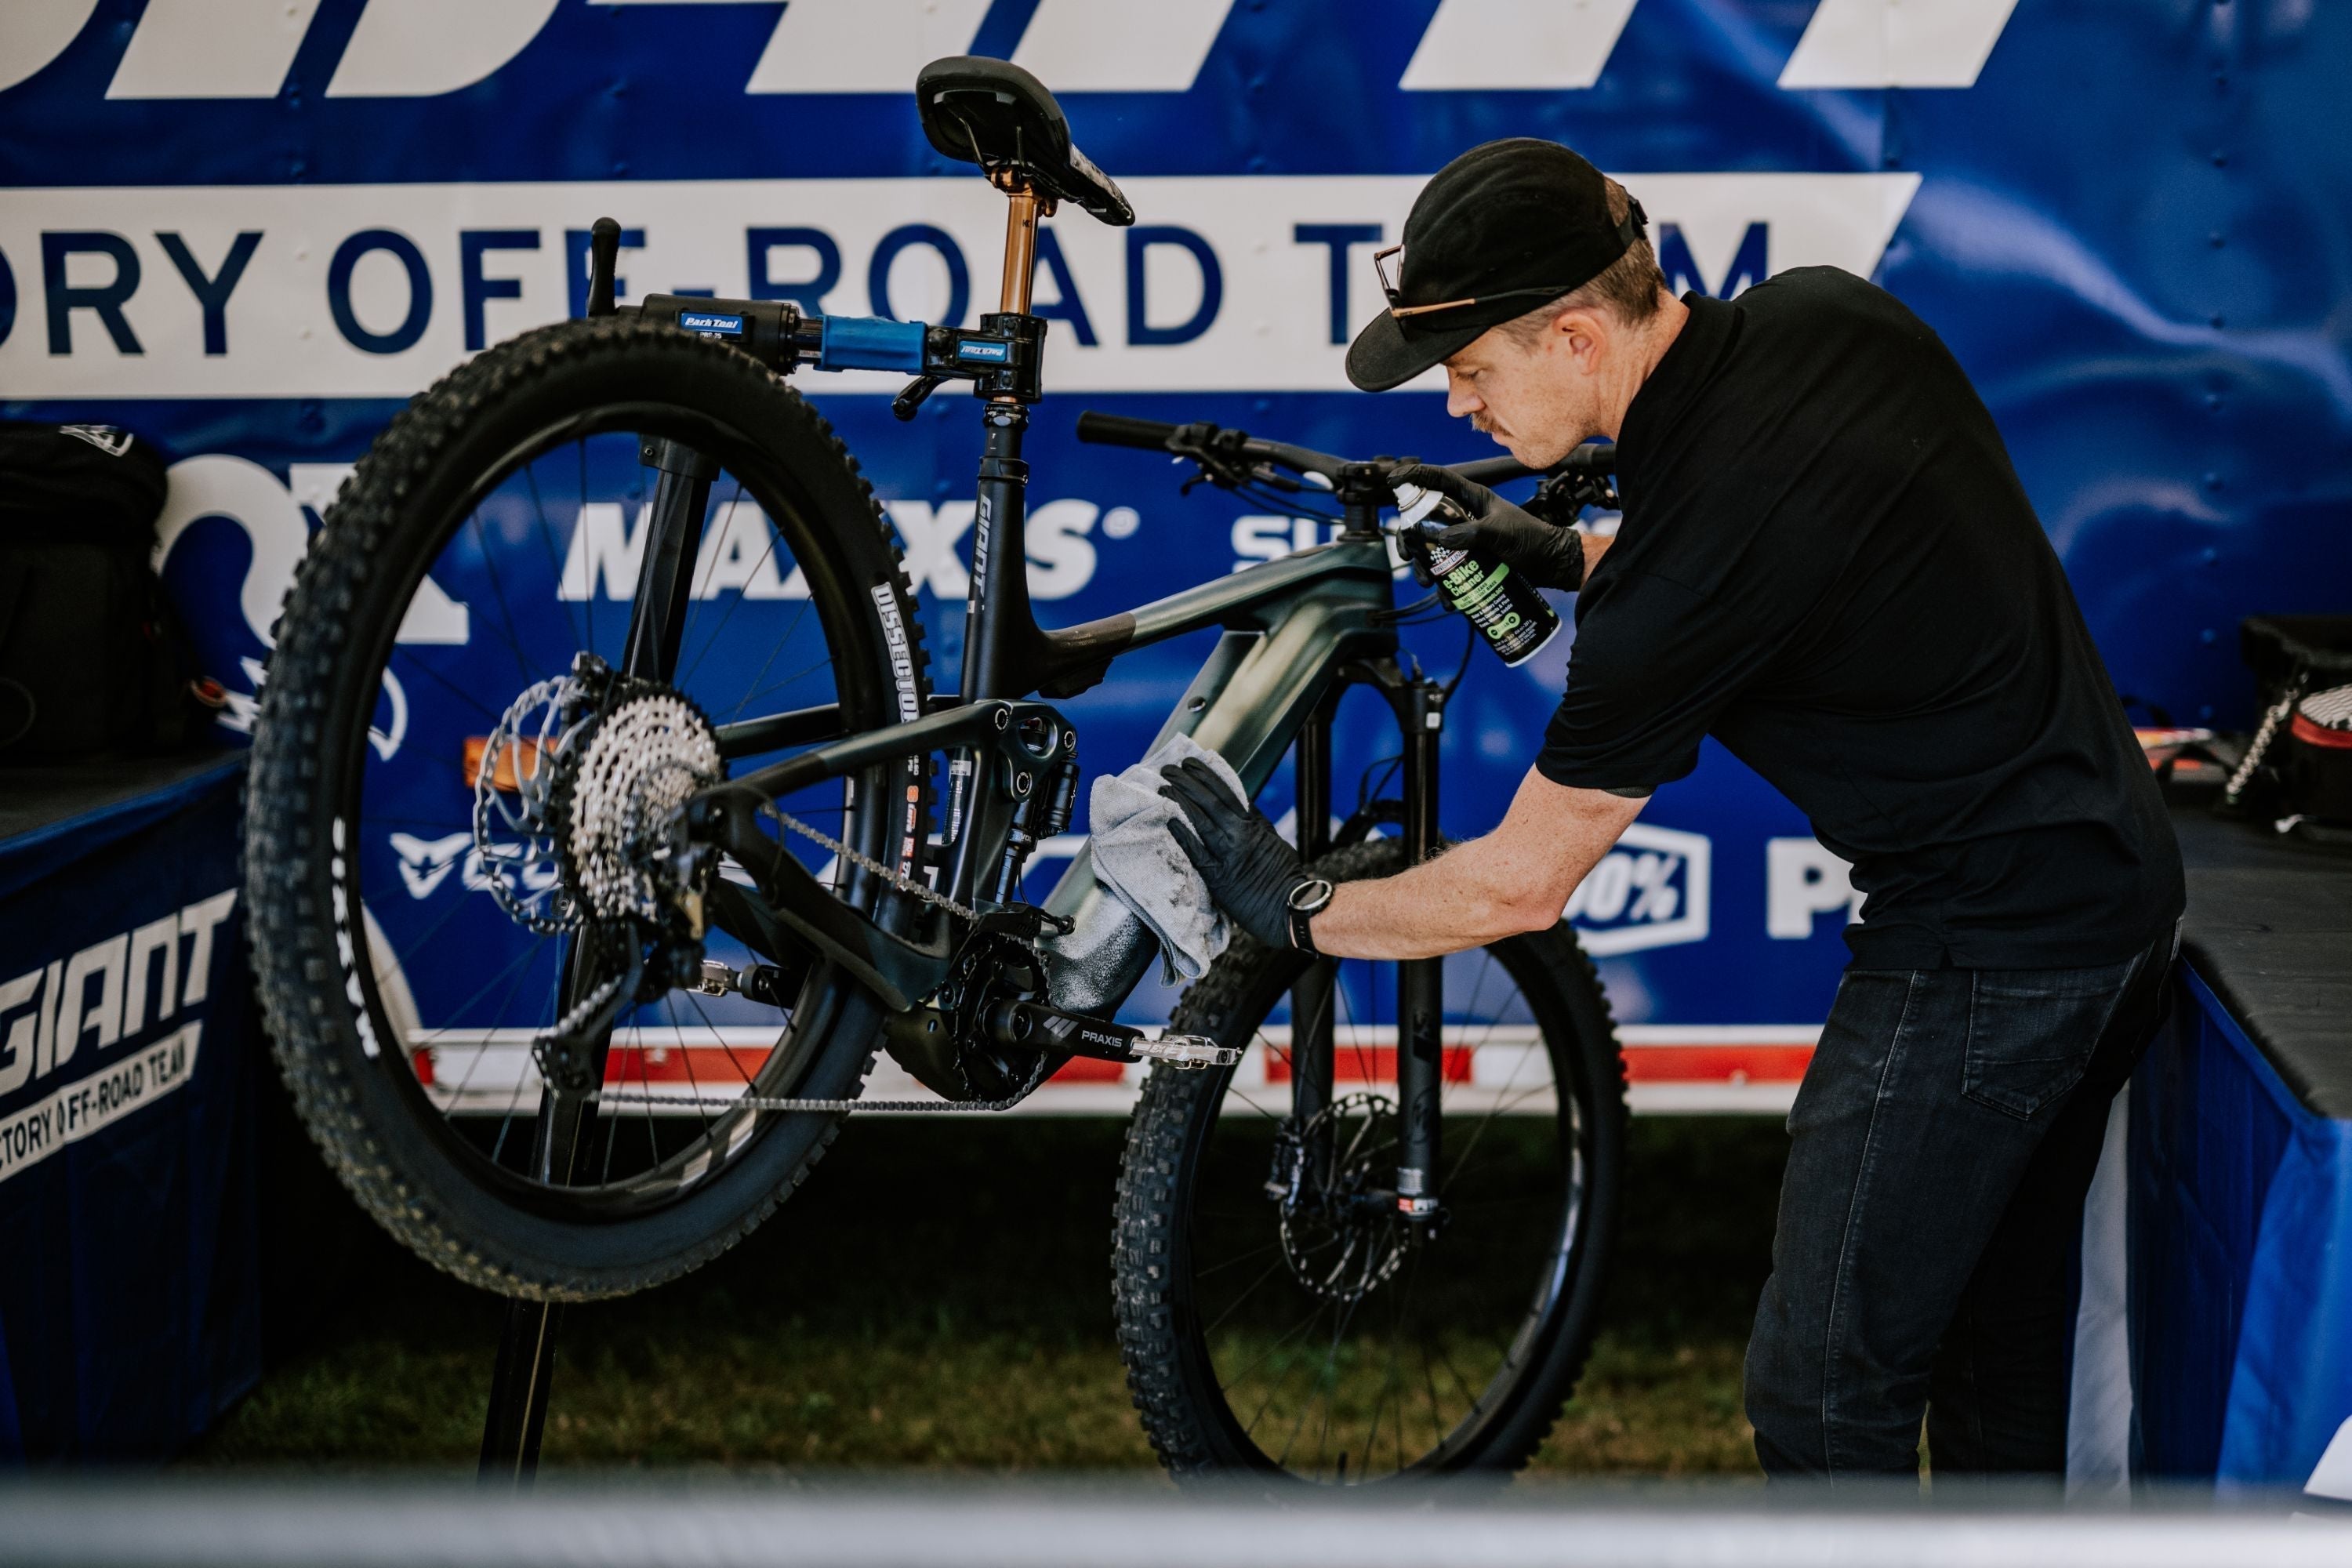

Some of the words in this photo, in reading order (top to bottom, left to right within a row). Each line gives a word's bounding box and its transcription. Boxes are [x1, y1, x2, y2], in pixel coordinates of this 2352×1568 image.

[0, 229, 267, 356] RY
[1294, 223, 1768, 346] TM
[684, 317, 713, 327] Park
[713, 318, 739, 328] Tool
[557, 499, 1099, 601] MAXS
[974, 494, 993, 597] GIANT
[1433, 560, 1451, 574] FINISH
[1450, 550, 1465, 563] LINE
[1443, 560, 1479, 590] e-Bike
[1450, 569, 1485, 597] Cleaner
[1561, 851, 1679, 921] 0%
[0, 887, 238, 1098] GIANT
[1081, 1029, 1123, 1047] PRAXIS
[0, 1109, 52, 1166] TORY
[56, 1062, 143, 1136] OFF-ROAD
[147, 1037, 187, 1087] TEAM
